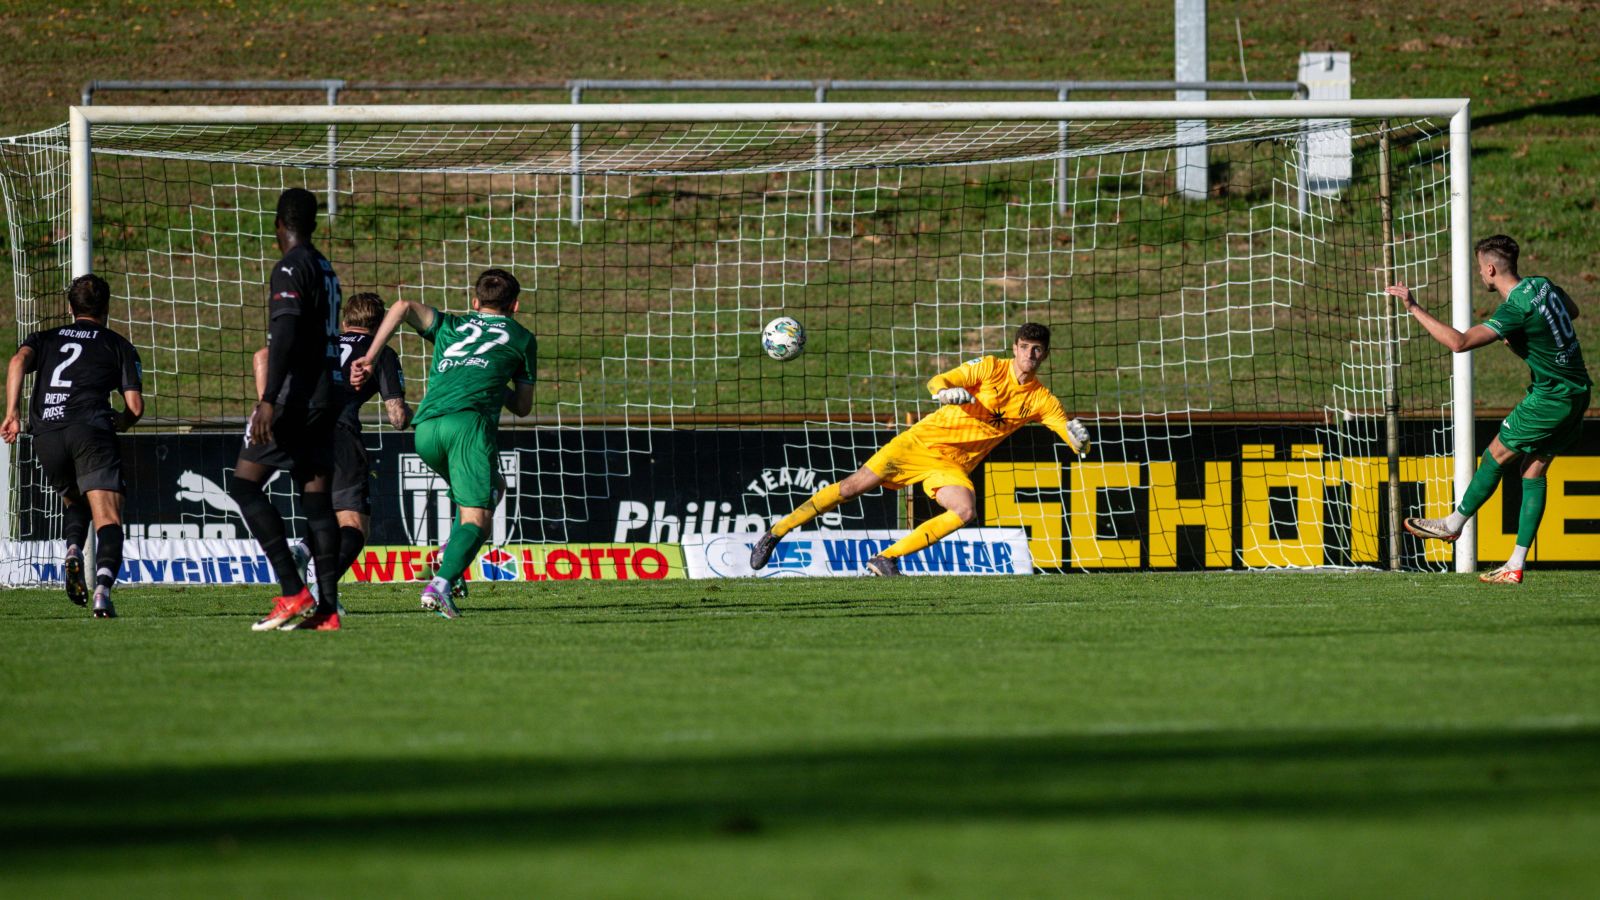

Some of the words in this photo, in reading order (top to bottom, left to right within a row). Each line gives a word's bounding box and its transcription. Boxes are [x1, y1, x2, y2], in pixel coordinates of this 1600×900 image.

[58, 329, 100, 340] BOCHOLT
[1538, 290, 1576, 348] 18
[442, 322, 510, 358] 27
[50, 342, 83, 388] 2
[523, 547, 669, 581] LOTTO
